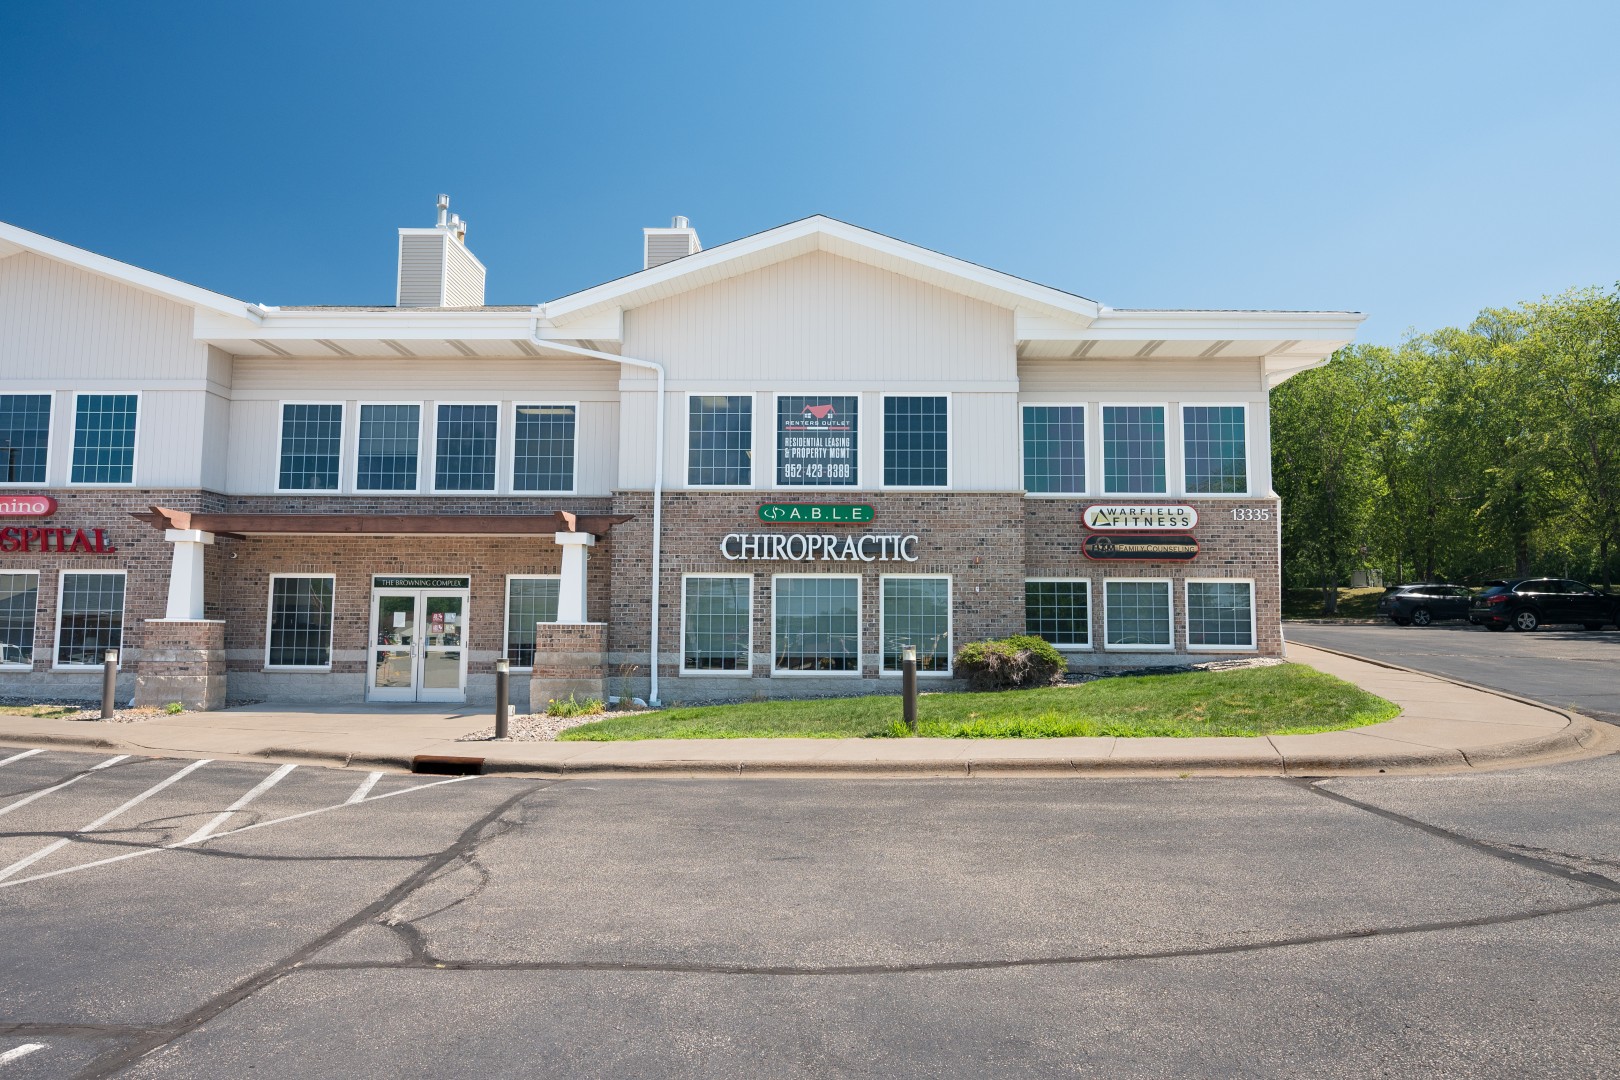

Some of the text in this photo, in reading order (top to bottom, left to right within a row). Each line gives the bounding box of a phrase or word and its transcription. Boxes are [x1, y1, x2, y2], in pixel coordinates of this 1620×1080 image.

[784, 437, 850, 447] RESIDENTIAL LEASING
[784, 447, 850, 459] & PROPERTY MGMT
[1106, 508, 1184, 516] WARFIELD
[1230, 508, 1269, 521] 13335
[1112, 517, 1189, 527] FITNESS
[0, 526, 116, 553] SPITAL
[720, 533, 919, 562] CHIROPRACTIC
[1118, 544, 1145, 552] FAMILY
[1146, 544, 1195, 553] COUNSELING
[432, 579, 462, 587] COMPLEX
